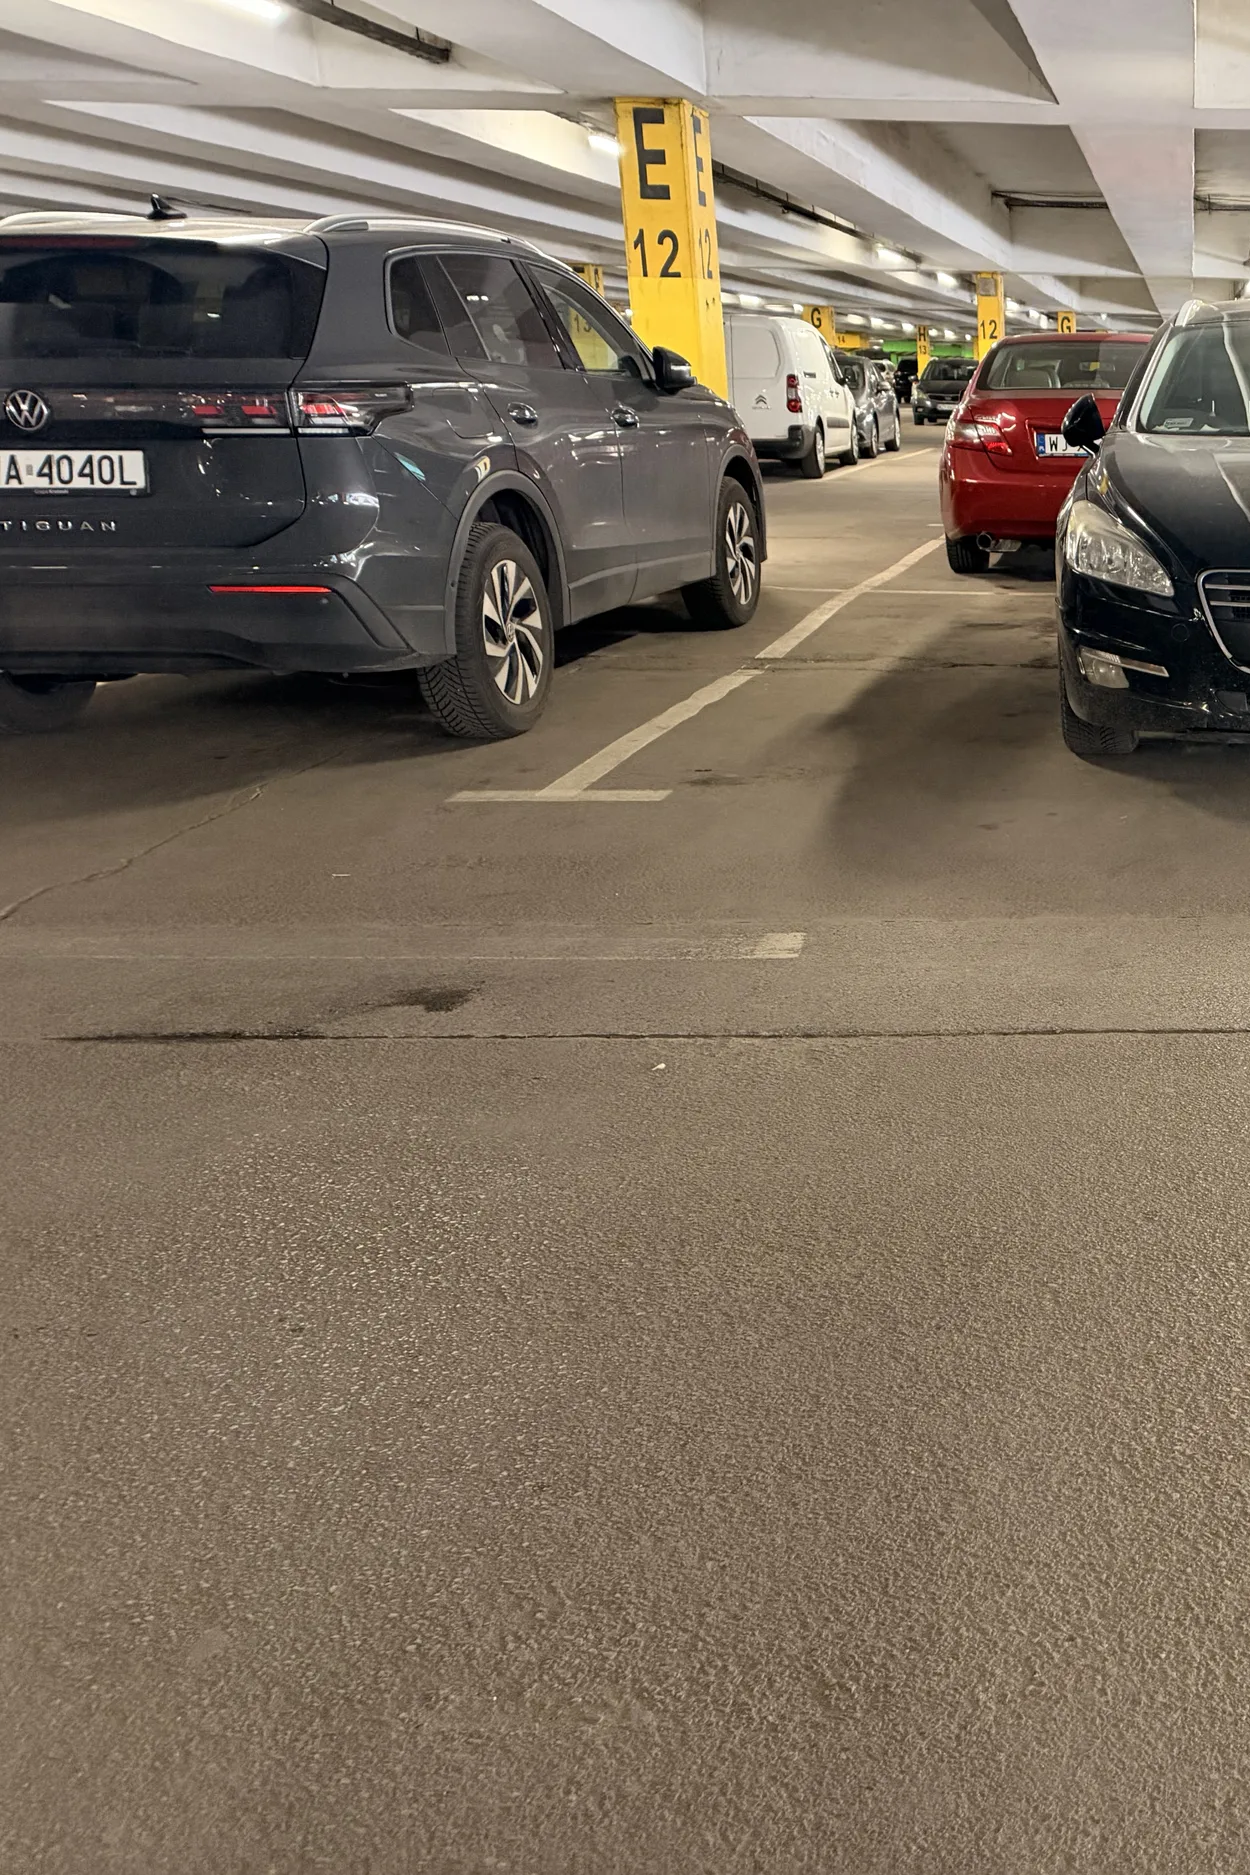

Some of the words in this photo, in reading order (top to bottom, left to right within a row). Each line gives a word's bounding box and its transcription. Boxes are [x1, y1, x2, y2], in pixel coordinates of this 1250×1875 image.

[632, 107, 671, 200] E
[692, 115, 706, 207] E
[633, 228, 682, 278] 12
[699, 227, 713, 279] 12
[811, 307, 822, 329] G
[980, 319, 998, 340] 12
[1060, 316, 1072, 333] G
[919, 326, 927, 342] H
[36, 454, 138, 486] 4040L
[0, 520, 116, 531] TIGUAN
